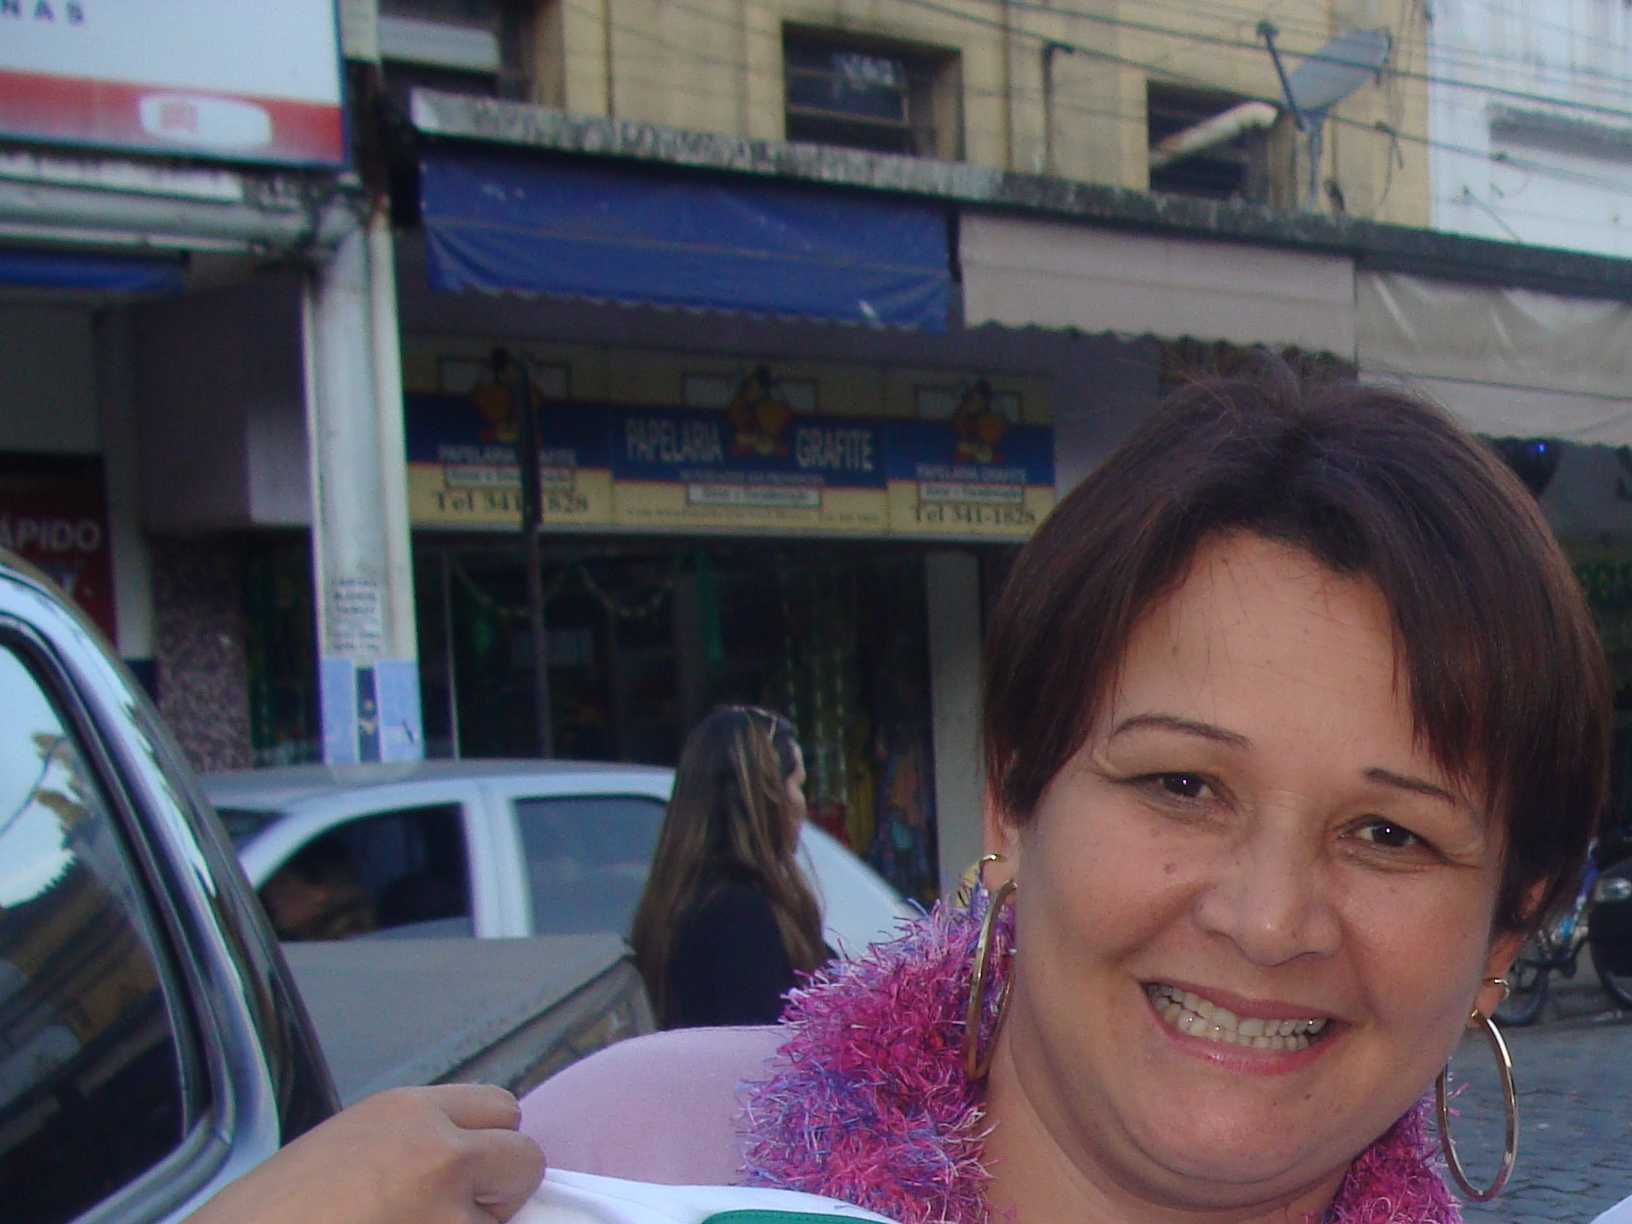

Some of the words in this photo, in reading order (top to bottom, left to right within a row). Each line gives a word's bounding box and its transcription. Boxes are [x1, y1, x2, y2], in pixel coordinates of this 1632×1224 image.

[626, 416, 723, 464] PAPELARIA
[796, 427, 874, 473] GRAFITE
[431, 491, 474, 512] Tel
[912, 504, 944, 522] Tel
